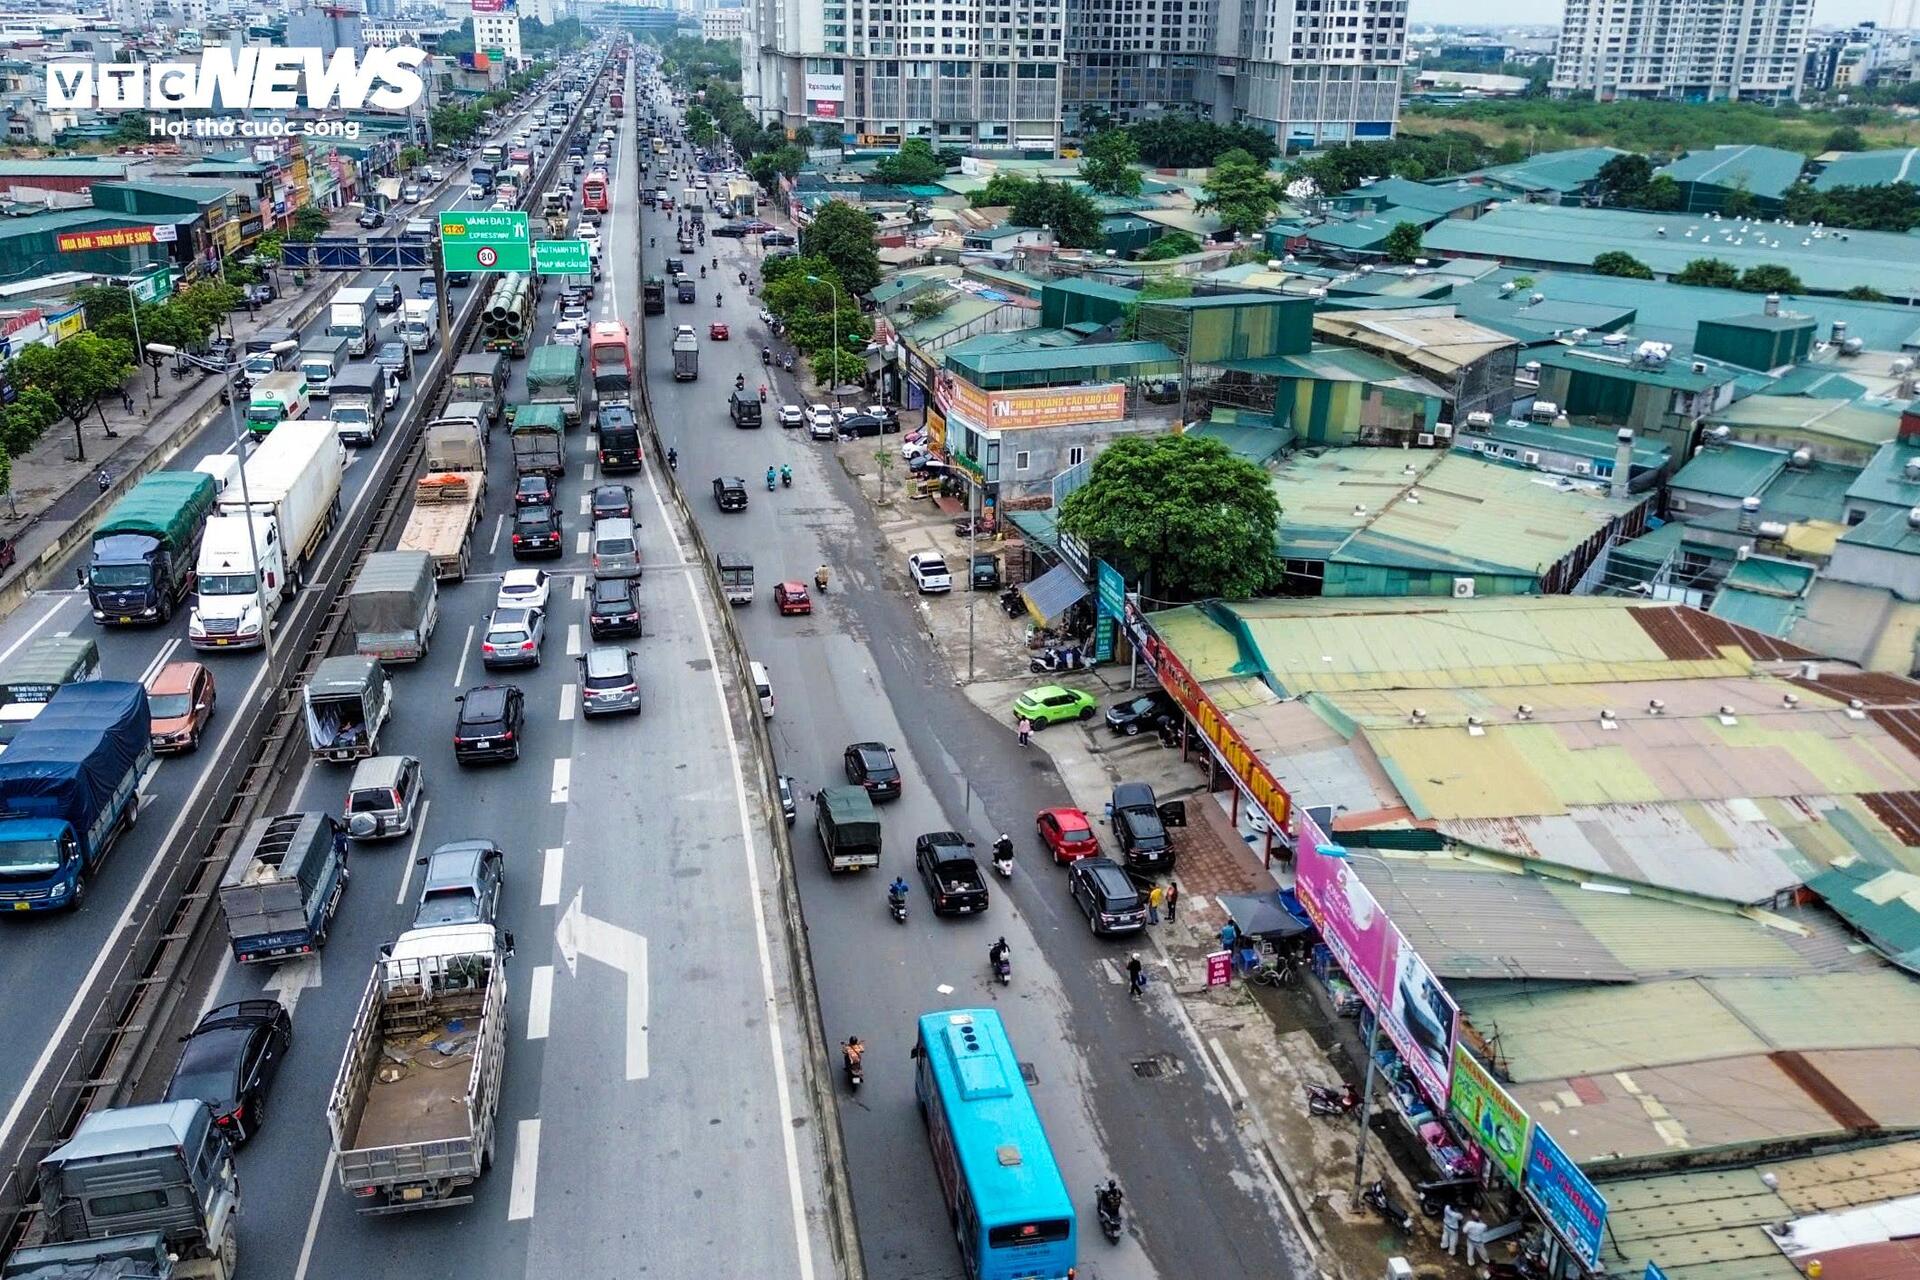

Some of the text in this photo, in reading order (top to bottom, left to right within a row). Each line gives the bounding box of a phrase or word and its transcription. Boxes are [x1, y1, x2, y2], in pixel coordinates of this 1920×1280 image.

[506, 217, 511, 225] 3
[125, 233, 135, 244] XE
[134, 231, 152, 243] SANG
